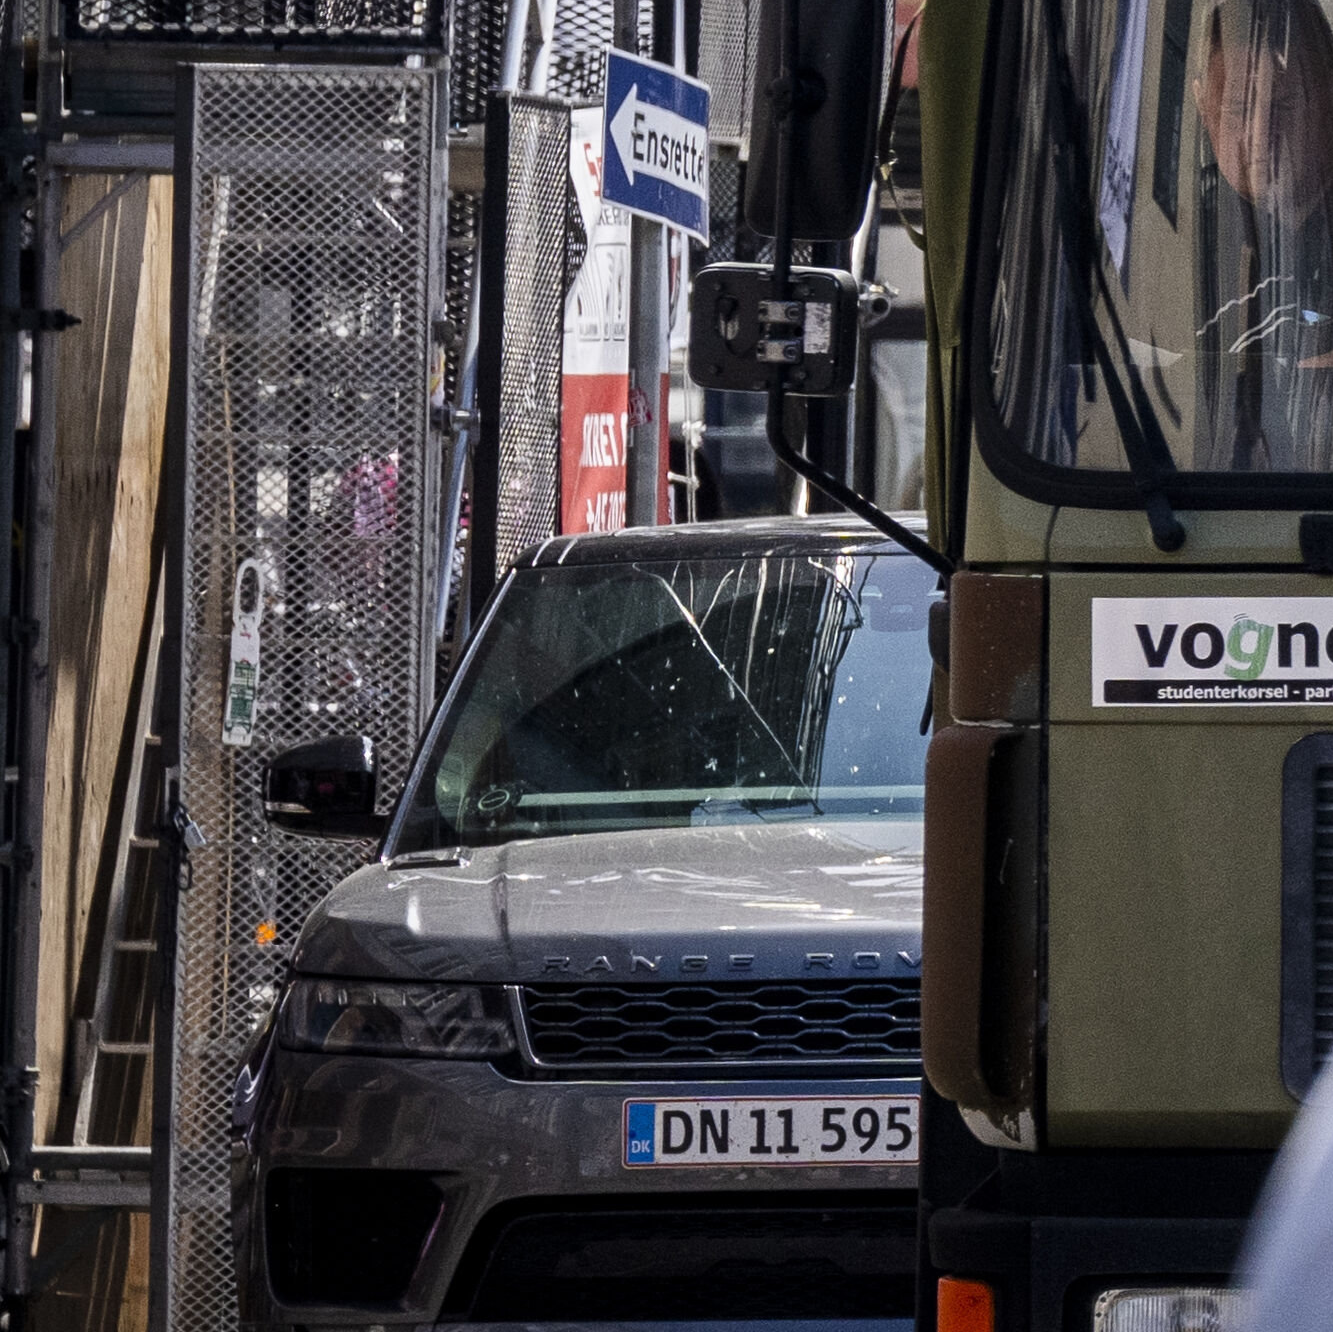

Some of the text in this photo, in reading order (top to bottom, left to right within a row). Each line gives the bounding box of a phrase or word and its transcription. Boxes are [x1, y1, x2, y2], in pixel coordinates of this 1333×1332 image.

[1157, 684, 1289, 699] studenterkørsel
[543, 954, 755, 973] RANGE
[661, 1106, 912, 1155] DN 11 595
[631, 1140, 651, 1153] DK
